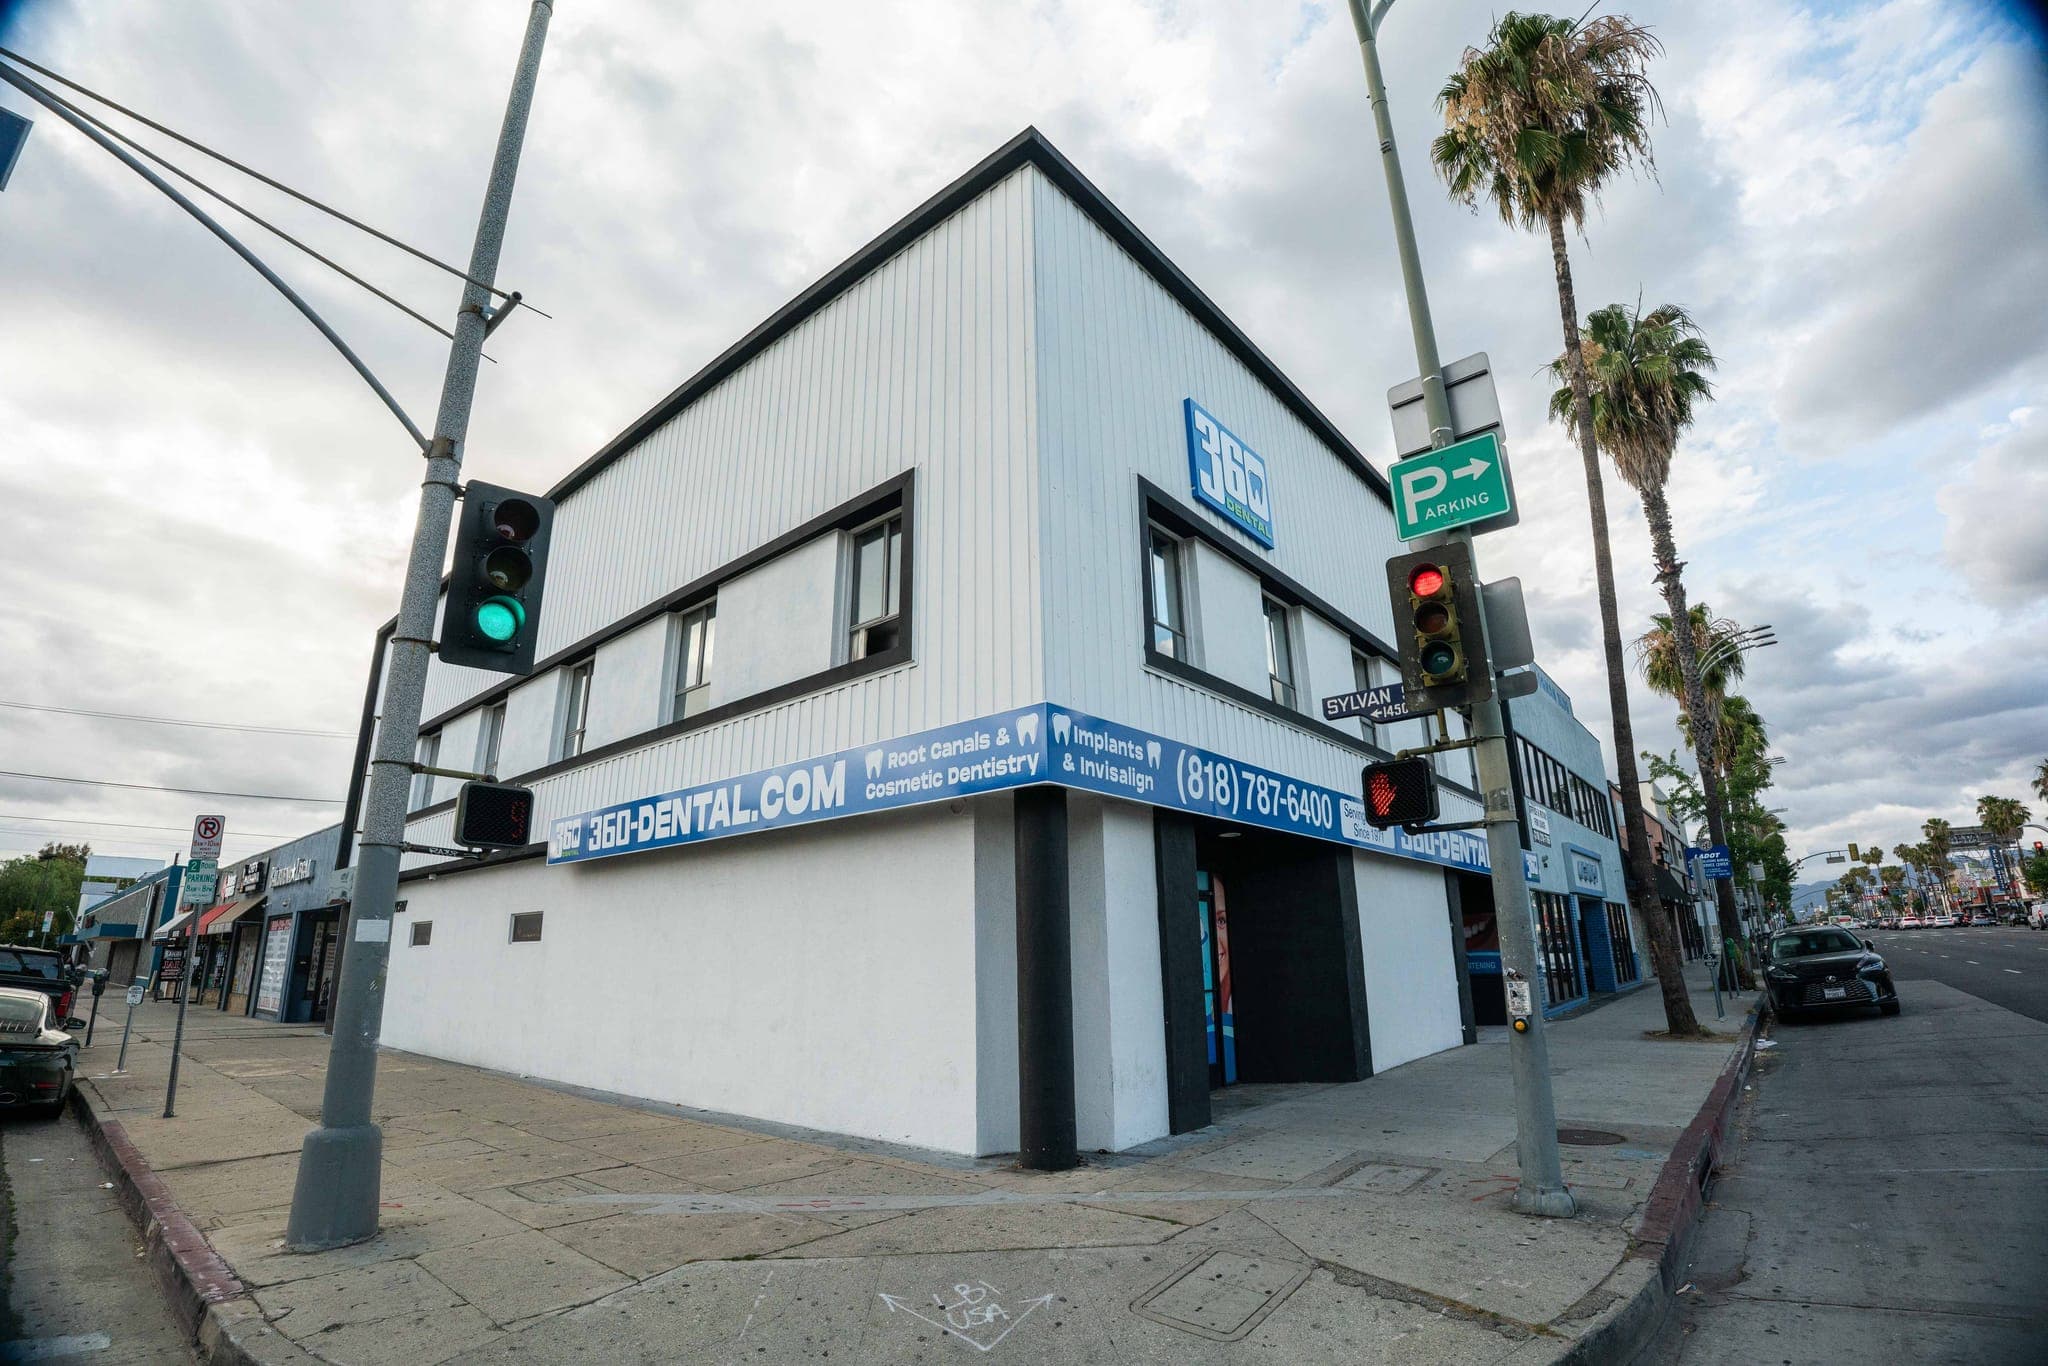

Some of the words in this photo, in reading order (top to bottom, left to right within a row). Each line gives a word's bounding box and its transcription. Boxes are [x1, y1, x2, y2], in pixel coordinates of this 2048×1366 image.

[1194, 409, 1270, 521] 360
[1226, 497, 1272, 539] DENTAL
[1327, 688, 1391, 715] SYLVAN
[888, 745, 926, 770] Root
[930, 731, 990, 760] Canals
[996, 728, 1010, 746] &
[1074, 725, 1143, 761] Implants
[865, 769, 943, 800] Cosmetic
[947, 752, 1040, 786] Dentistry
[1062, 752, 1075, 773] &
[1080, 757, 1154, 794] Invisalign
[1177, 749, 1239, 815] (818)
[1242, 770, 1333, 831] 787-6400
[553, 819, 581, 858] 360
[588, 760, 846, 851] 360-DENTAL.COM
[1353, 822, 1370, 840] Since
[187, 873, 215, 883] PARKING
[191, 861, 198, 872] 2
